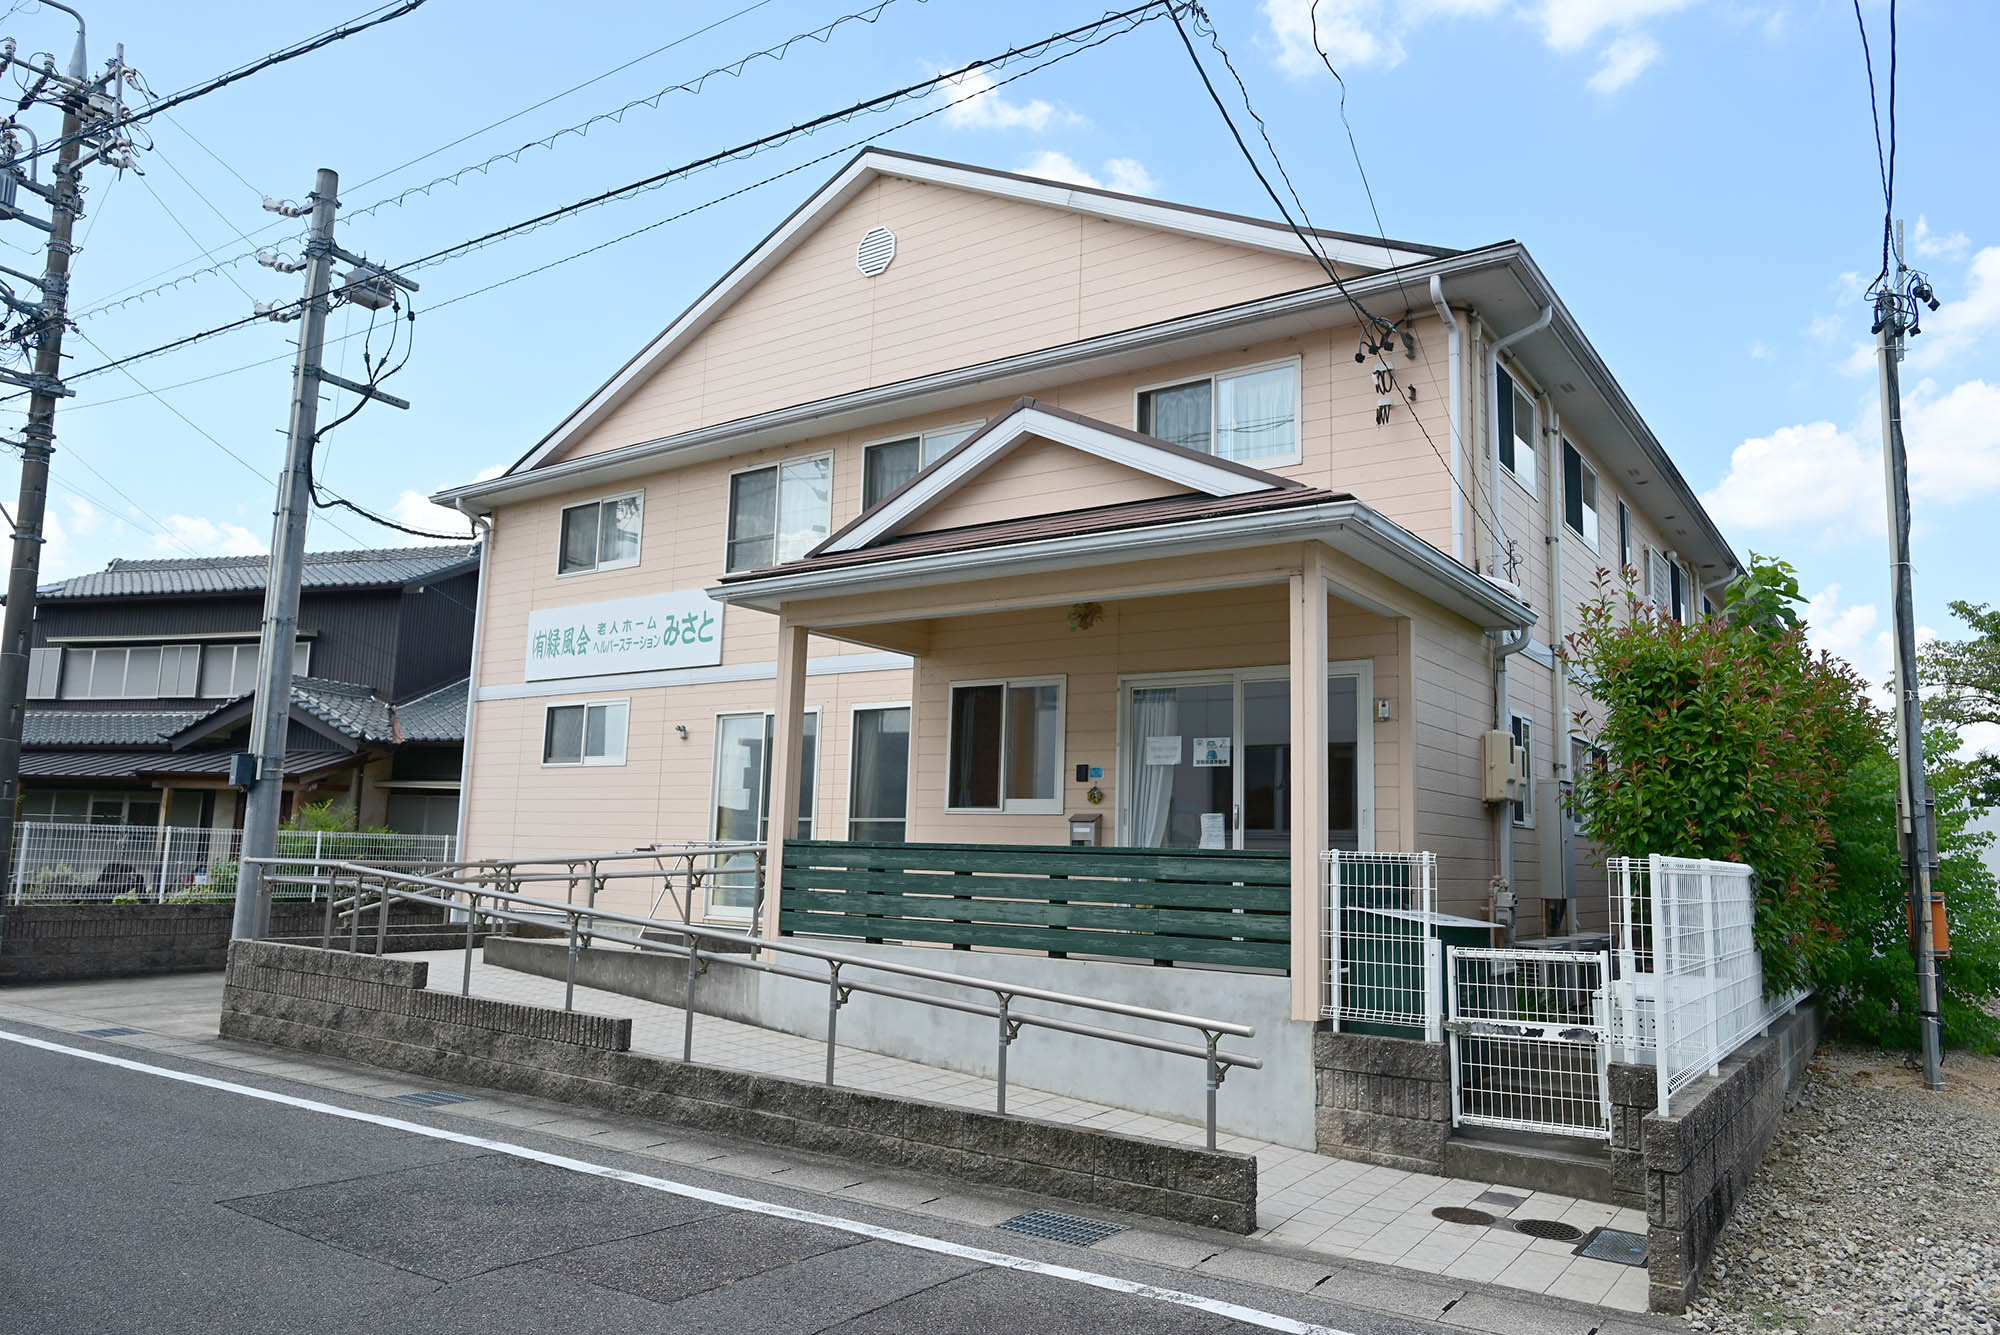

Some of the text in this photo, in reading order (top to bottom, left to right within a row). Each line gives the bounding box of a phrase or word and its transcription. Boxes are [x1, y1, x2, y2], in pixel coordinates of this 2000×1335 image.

[597, 616, 657, 636] 老人ホーム
[663, 611, 714, 646] みさと
